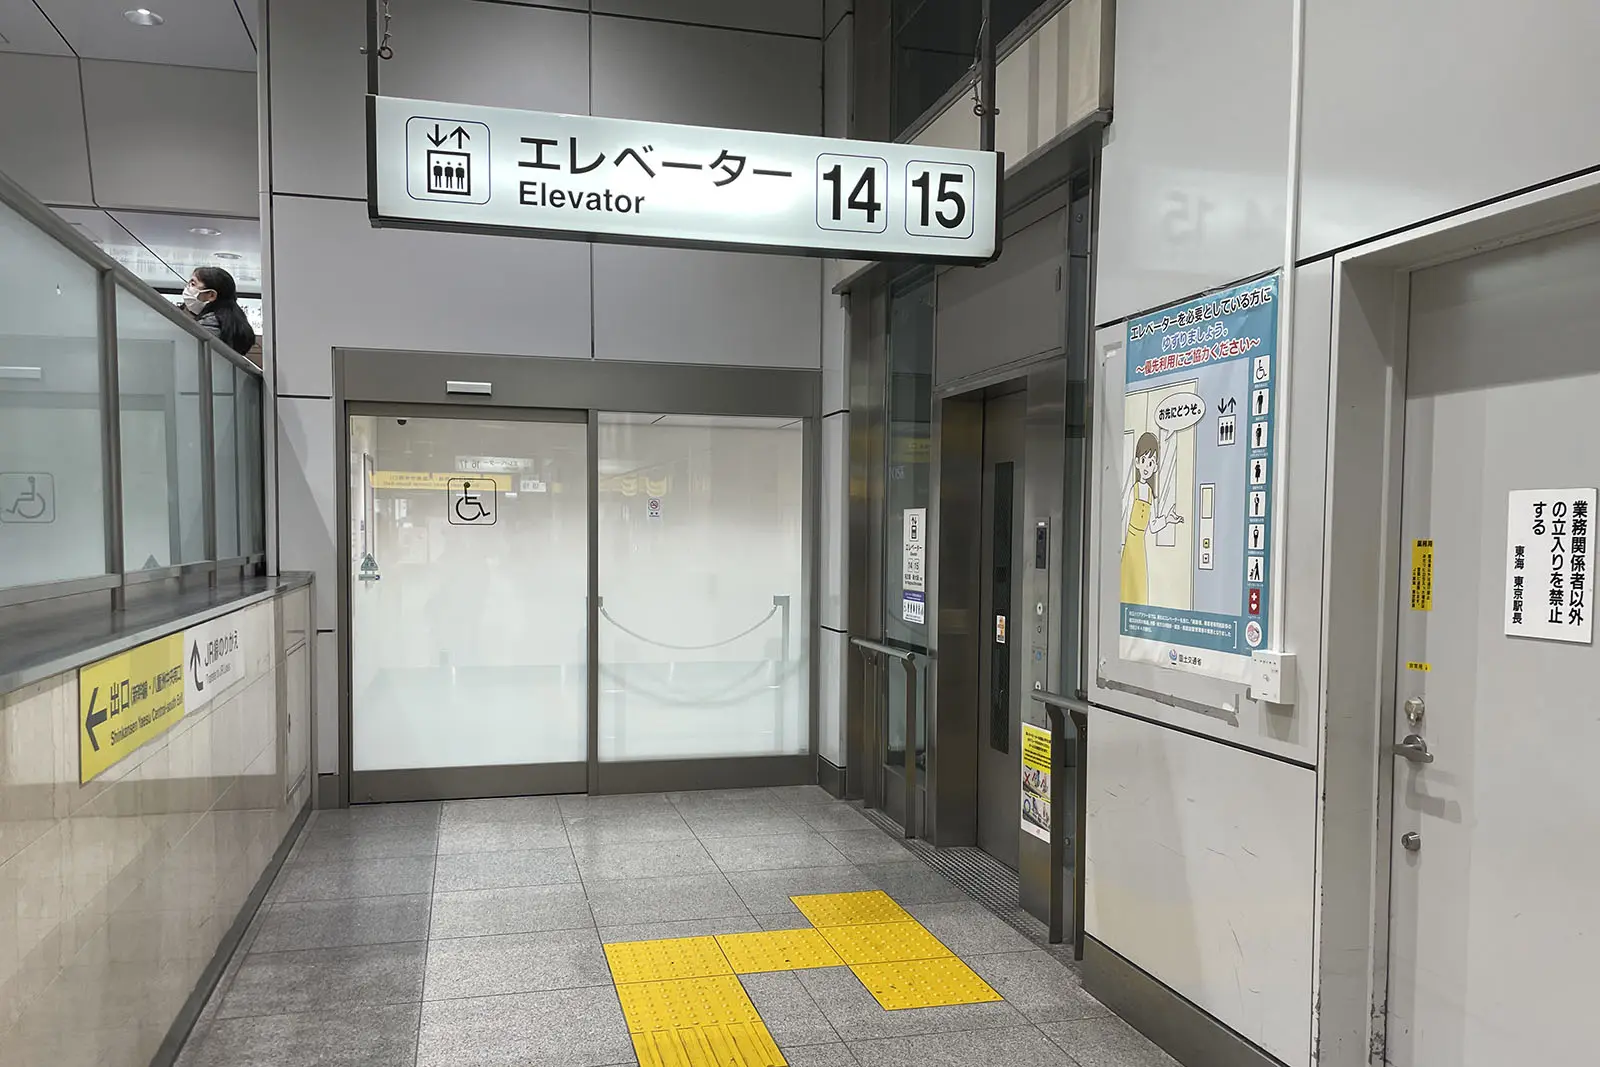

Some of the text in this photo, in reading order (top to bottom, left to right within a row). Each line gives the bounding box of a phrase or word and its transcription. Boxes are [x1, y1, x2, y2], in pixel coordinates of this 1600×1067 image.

[517, 136, 968, 230] エレベーター 14 15
[519, 181, 645, 215] Elevator
[1130, 287, 1272, 340] エレベーターを必要としている方に
[1162, 322, 1229, 351] ゆずりましょう。
[1158, 403, 1202, 420] お先にどうぞ。
[1532, 501, 1547, 535] する
[1512, 545, 1525, 625] 東海 東京駅長
[1548, 501, 1567, 624] の立入りを禁止
[1568, 500, 1588, 626] 業務関係者以外
